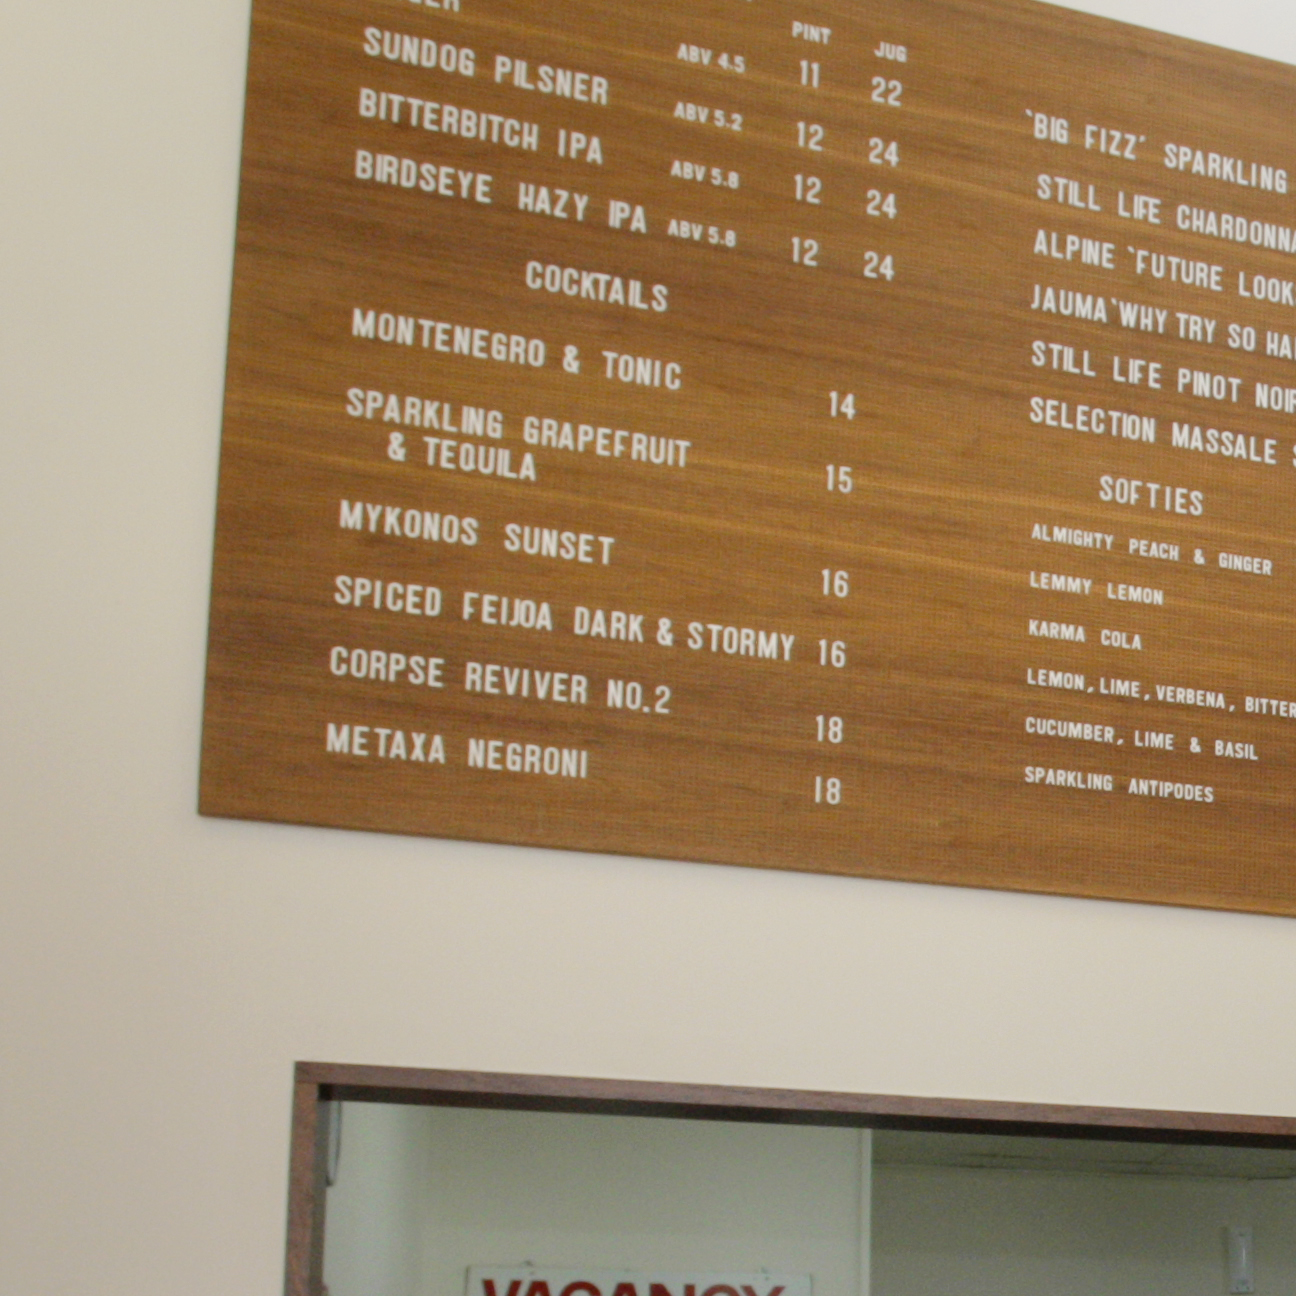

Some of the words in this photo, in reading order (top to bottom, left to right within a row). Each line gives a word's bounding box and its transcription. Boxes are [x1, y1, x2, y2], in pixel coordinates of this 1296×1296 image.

[363, 26, 476, 77] SUNDOG
[494, 55, 609, 105] PILSNER
[359, 87, 539, 151] BITTERBITCH
[558, 129, 603, 165] IPA
[355, 149, 493, 203] BIRDSEYE
[518, 182, 589, 221] HAZY
[608, 199, 647, 233] IPA
[1164, 143, 1288, 194] SPARKLING
[1037, 174, 1101, 211] STILL
[1118, 191, 1162, 224] LIFE
[1034, 229, 1115, 269] ALPINE
[526, 260, 668, 312] COCKTAILS
[1031, 284, 1107, 323] JAUMA
[1175, 312, 1217, 343] TRY
[1227, 323, 1256, 351] SO
[352, 307, 546, 367] MONTENEGRO
[562, 344, 581, 374] &
[602, 351, 682, 391] TONIC
[1031, 340, 1096, 377] STILL
[1113, 356, 1162, 389] LIFE
[1178, 368, 1242, 402] PINOT
[346, 387, 503, 438] SPARKLING
[523, 416, 692, 467] GRAPEFRUIT
[1029, 396, 1157, 443] SELECTION
[1172, 422, 1277, 465] MASSALE
[387, 431, 406, 462] &
[424, 437, 536, 481] TEQUILA
[1099, 475, 1204, 516] SOFTIES
[339, 499, 479, 546] MYKONOS
[504, 523, 616, 565] SUNSET
[1031, 523, 1114, 550] ALMIGHTY
[1129, 538, 1180, 561] PEACH
[1218, 552, 1273, 575] GINGER
[1029, 571, 1092, 595] LEMMY
[1107, 582, 1164, 605] LEMON
[334, 575, 442, 616] SPICED
[463, 591, 553, 631] FEIJOA
[574, 606, 644, 642] DARK
[656, 617, 674, 646] &
[687, 621, 795, 661] STORMY
[1029, 619, 1086, 642] KARMA
[1101, 629, 1142, 650] COLA
[330, 646, 445, 688] CORPSE
[465, 662, 588, 704] REVIVER
[607, 679, 672, 714] NO.2
[1027, 668, 1094, 693] LEMON,
[1100, 677, 1151, 701] LIME,
[1156, 685, 1235, 712] VERBENA,
[326, 723, 446, 764] METAXA
[468, 738, 588, 778] NEGRONI
[1025, 716, 1124, 745] CUCUMBER,
[1134, 730, 1174, 750] LIME
[1215, 740, 1259, 760] BASIL
[1024, 766, 1113, 791] SPARKLING
[1128, 778, 1214, 803] ANTIPODES
